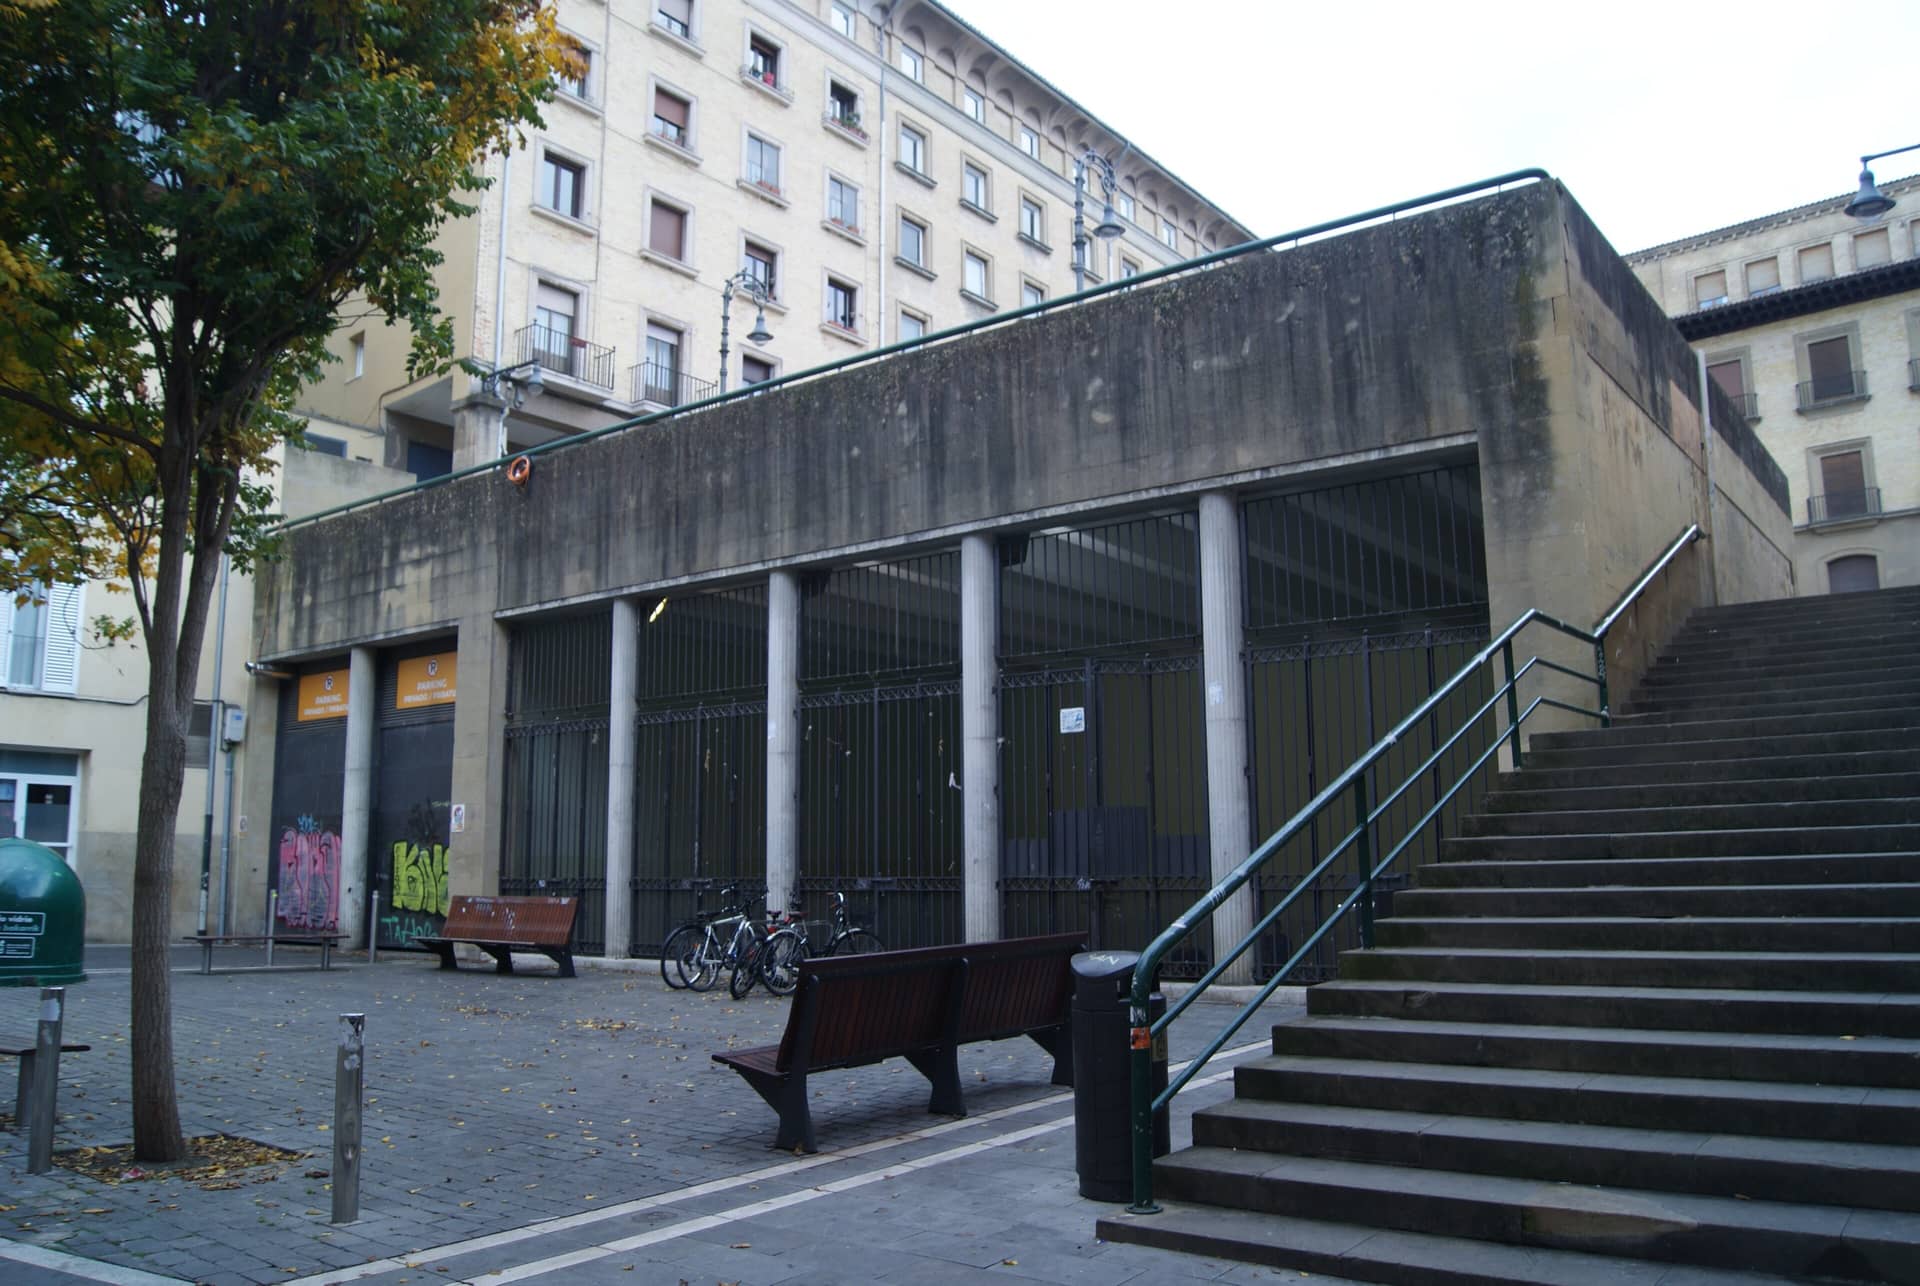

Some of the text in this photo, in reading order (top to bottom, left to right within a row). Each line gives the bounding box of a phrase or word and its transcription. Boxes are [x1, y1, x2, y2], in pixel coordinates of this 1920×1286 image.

[416, 679, 447, 690] PARKING
[315, 693, 342, 704] PARKING
[8, 915, 33, 923] vidrio
